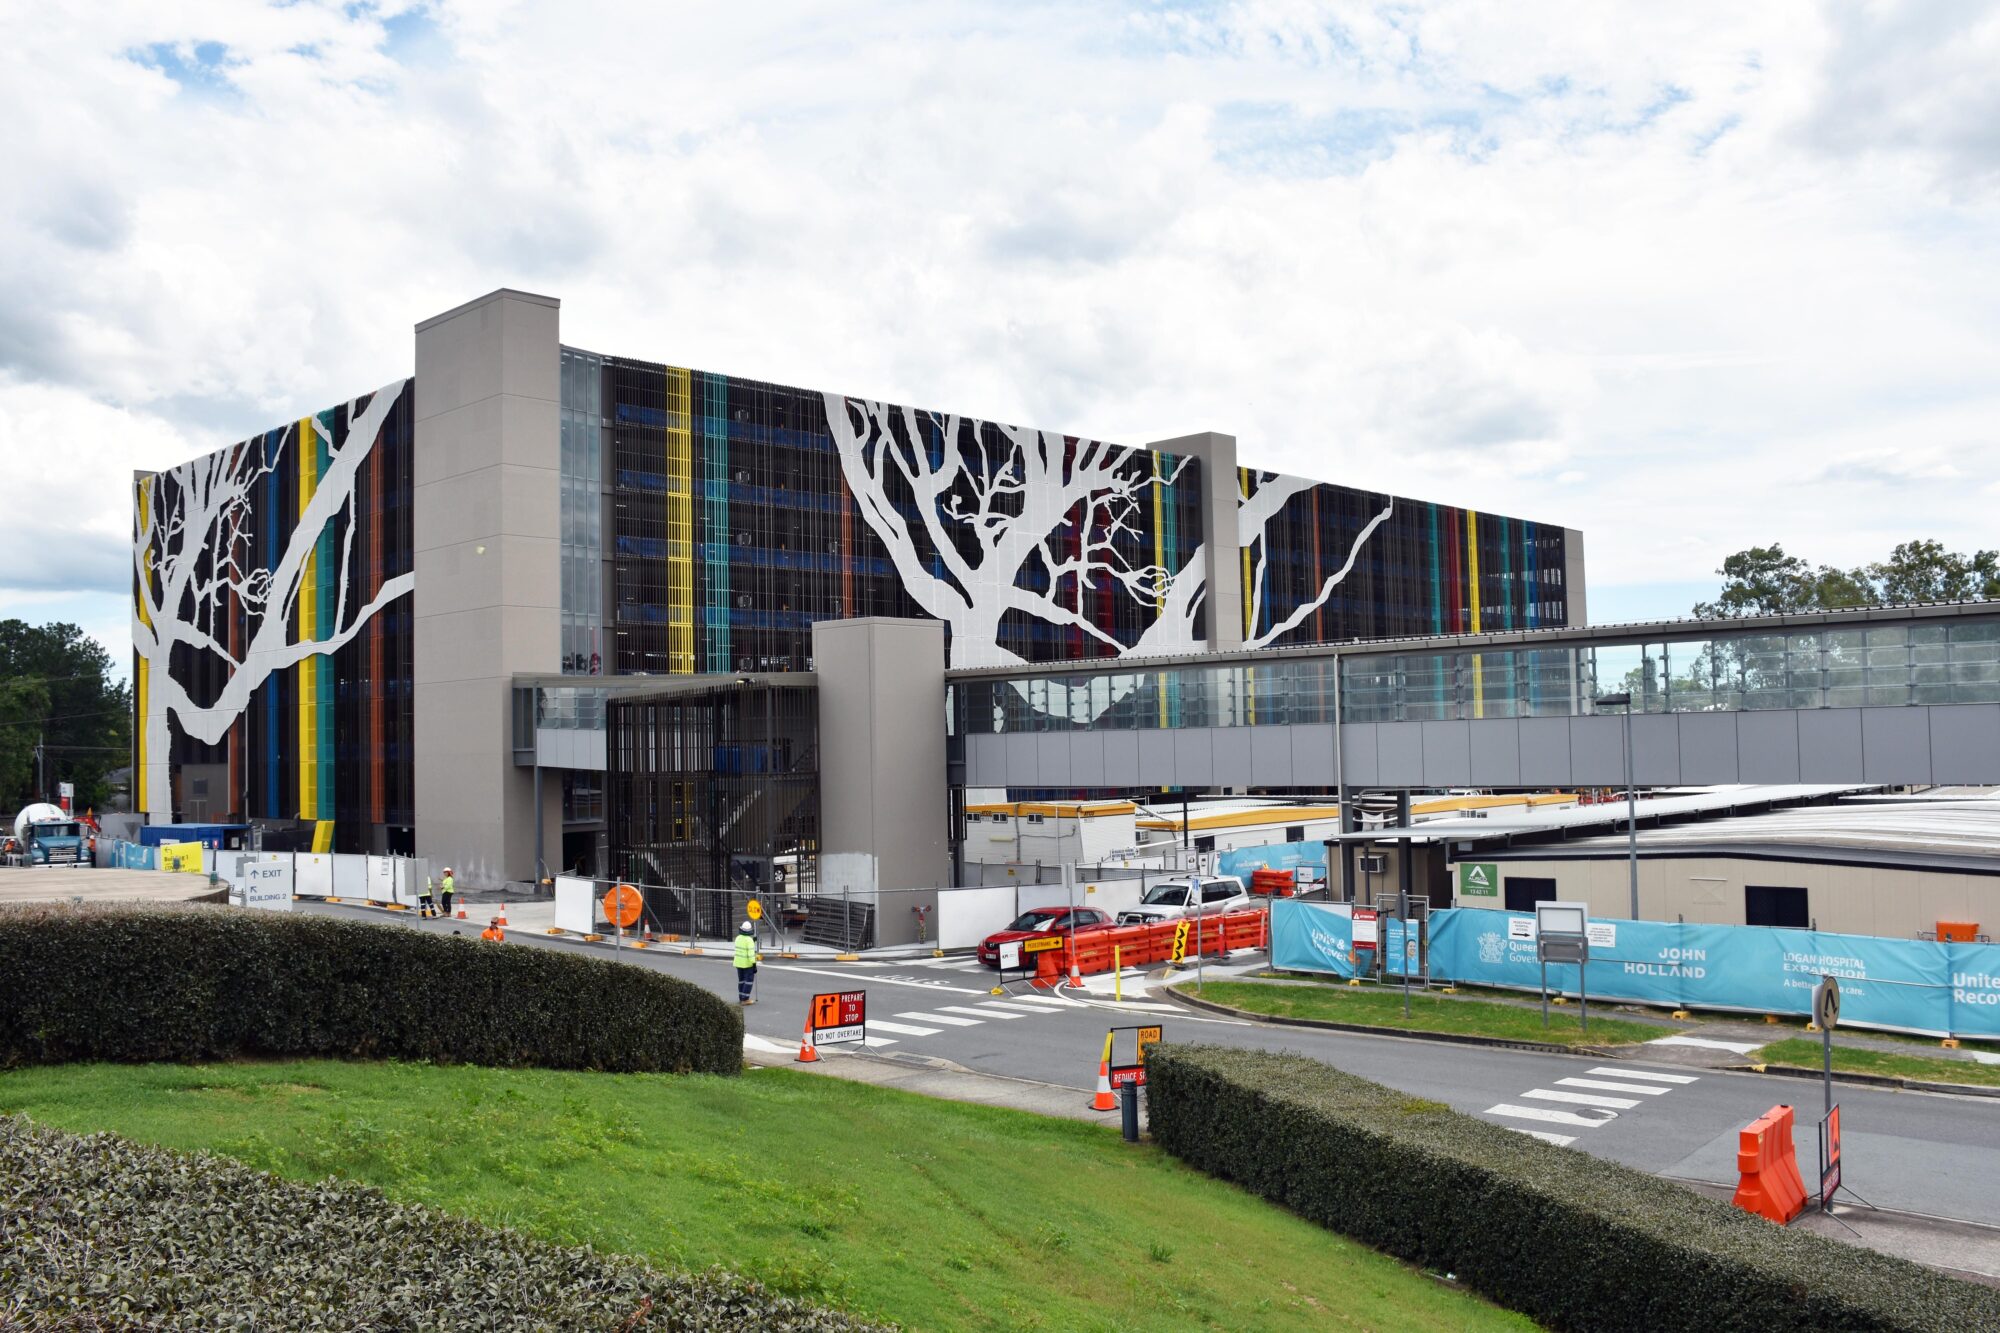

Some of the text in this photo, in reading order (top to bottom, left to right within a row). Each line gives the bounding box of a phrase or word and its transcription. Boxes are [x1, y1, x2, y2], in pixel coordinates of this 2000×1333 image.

[262, 869, 282, 878] EXIT
[249, 894, 280, 902] BUILDING
[1658, 947, 1706, 961] JOHN
[1783, 952, 1866, 970] LOGAN HOSPITAL
[1624, 961, 1706, 979] HOLLAND
[1783, 963, 1866, 979] EXPANSION
[1783, 979, 1790, 987] A
[1845, 987, 1865, 996] care.
[841, 993, 864, 1002] PREPARE
[849, 1004, 856, 1012] TO
[844, 1013, 859, 1022] STOP
[817, 1033, 824, 1041] DO
[837, 1029, 862, 1038] OVERTAKE
[1140, 1030, 1158, 1039] ROAD
[1113, 1071, 1137, 1084] REDUCE
